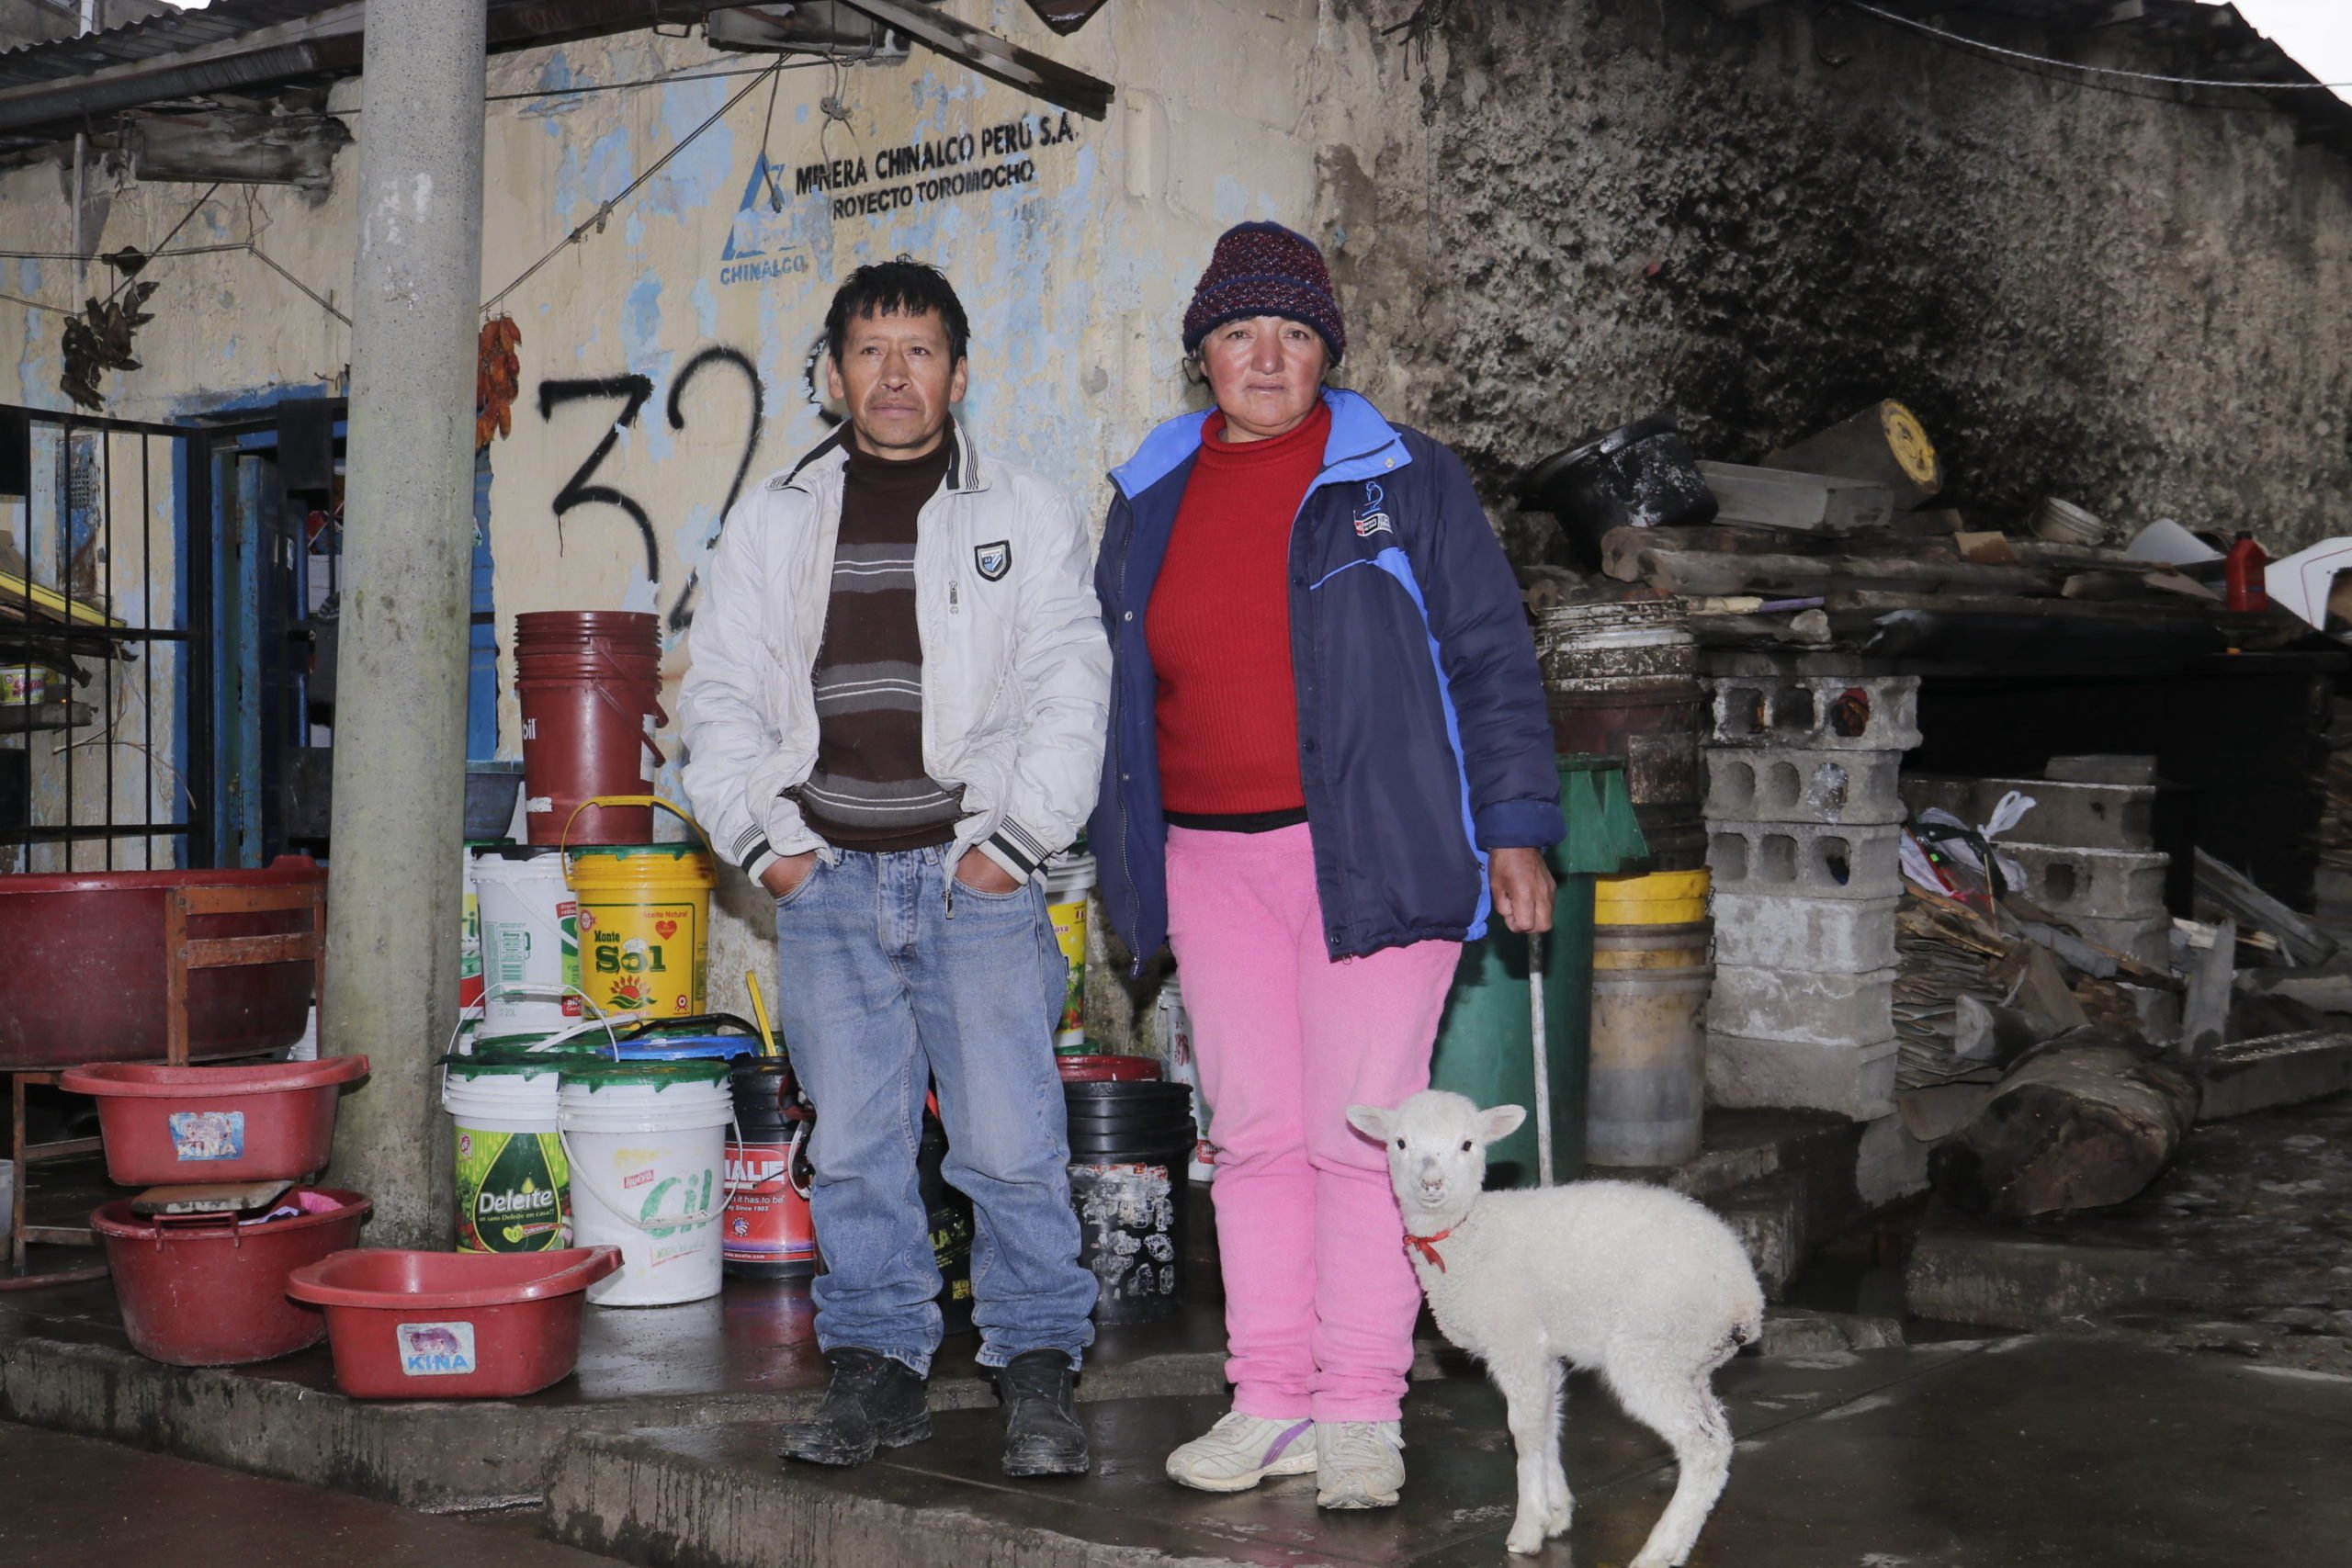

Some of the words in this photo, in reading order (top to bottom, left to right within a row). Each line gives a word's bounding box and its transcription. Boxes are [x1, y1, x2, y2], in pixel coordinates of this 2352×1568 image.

[796, 156, 867, 195] MINERA
[875, 133, 975, 178] CHINALCO
[981, 112, 1033, 157] PERÚ
[1040, 111, 1080, 147] S.A.
[918, 159, 1035, 202] TOROMOCHO
[719, 254, 808, 285] CHINALCO
[665, 910, 688, 919] Natural
[594, 930, 620, 942] Monte
[595, 945, 666, 974] Sol
[177, 1139, 237, 1156] KINA
[479, 1189, 554, 1213] Deleite
[640, 1168, 713, 1239] Cil
[744, 1195, 759, 1203] has
[502, 1213, 525, 1221] Deleite
[407, 1354, 469, 1371] KINA
